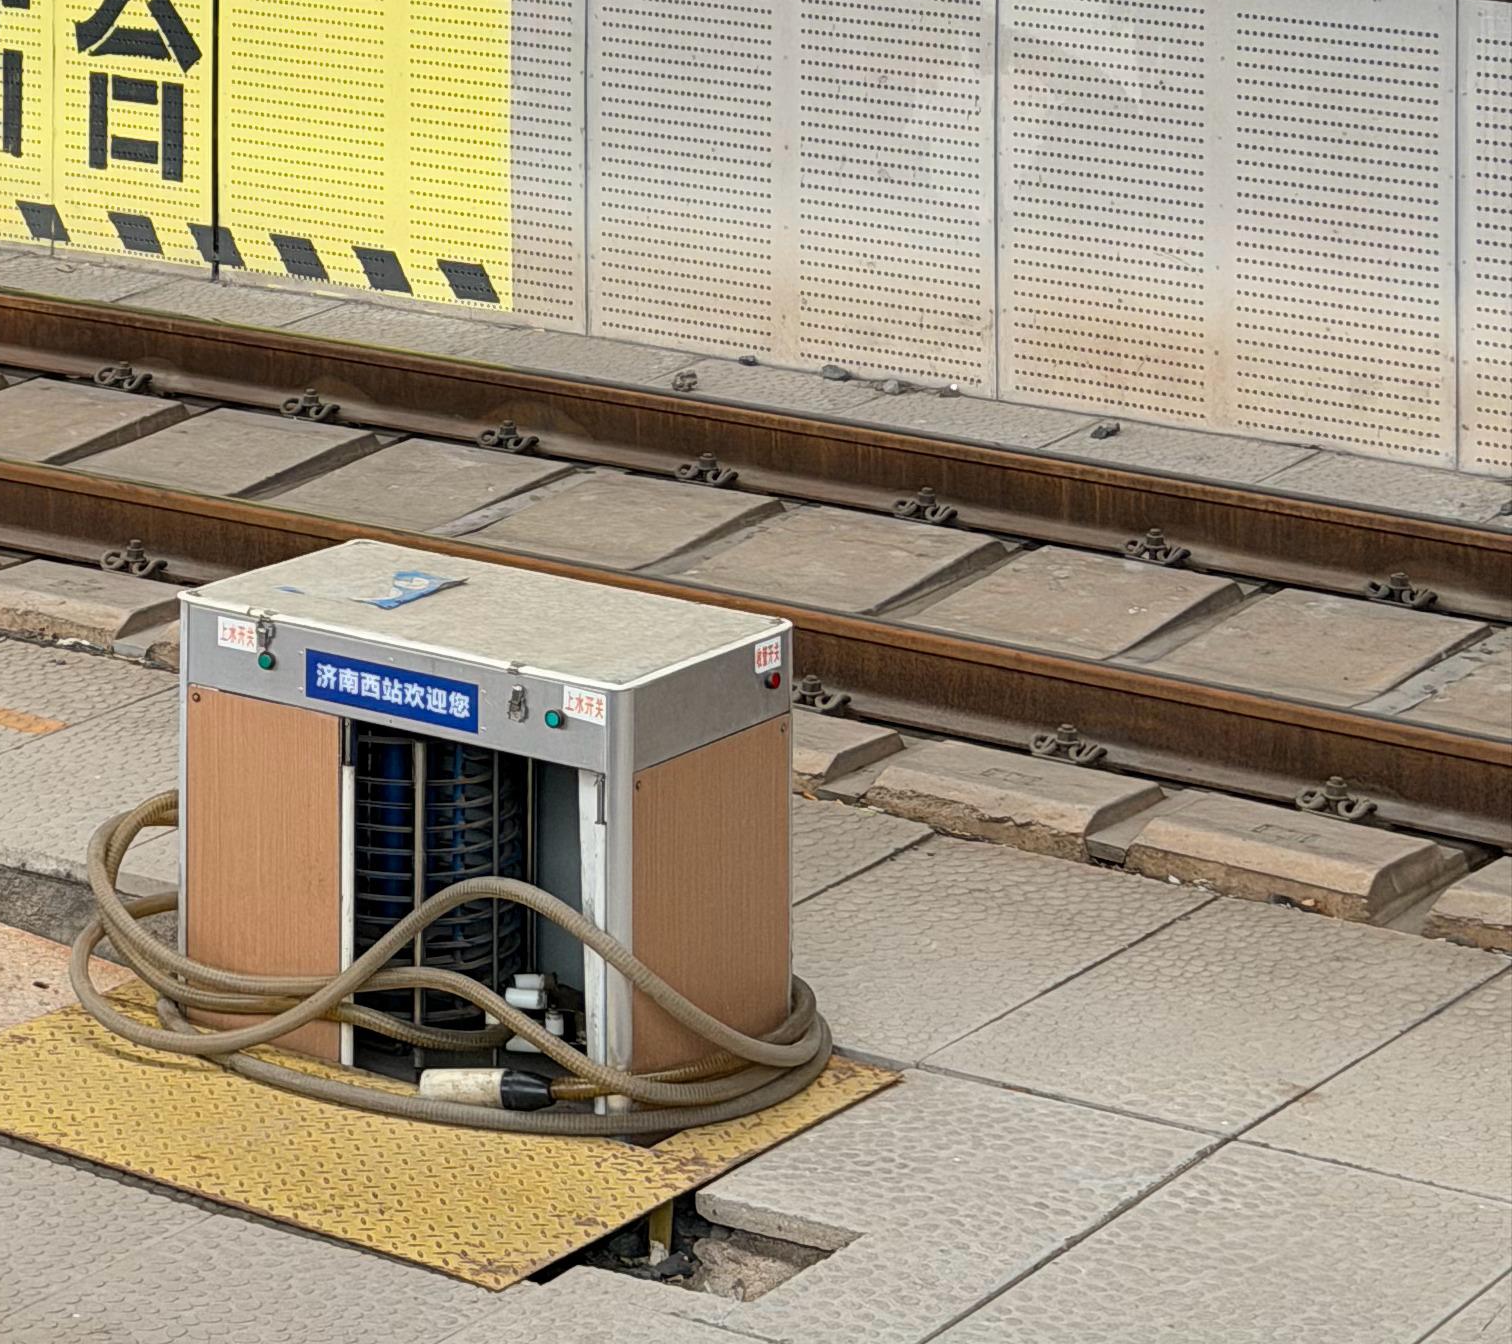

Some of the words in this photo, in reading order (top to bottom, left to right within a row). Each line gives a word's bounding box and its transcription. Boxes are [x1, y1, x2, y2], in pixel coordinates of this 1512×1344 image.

[316, 663, 471, 719] 济南西站欢迎您
[565, 691, 604, 720] 上水开关
